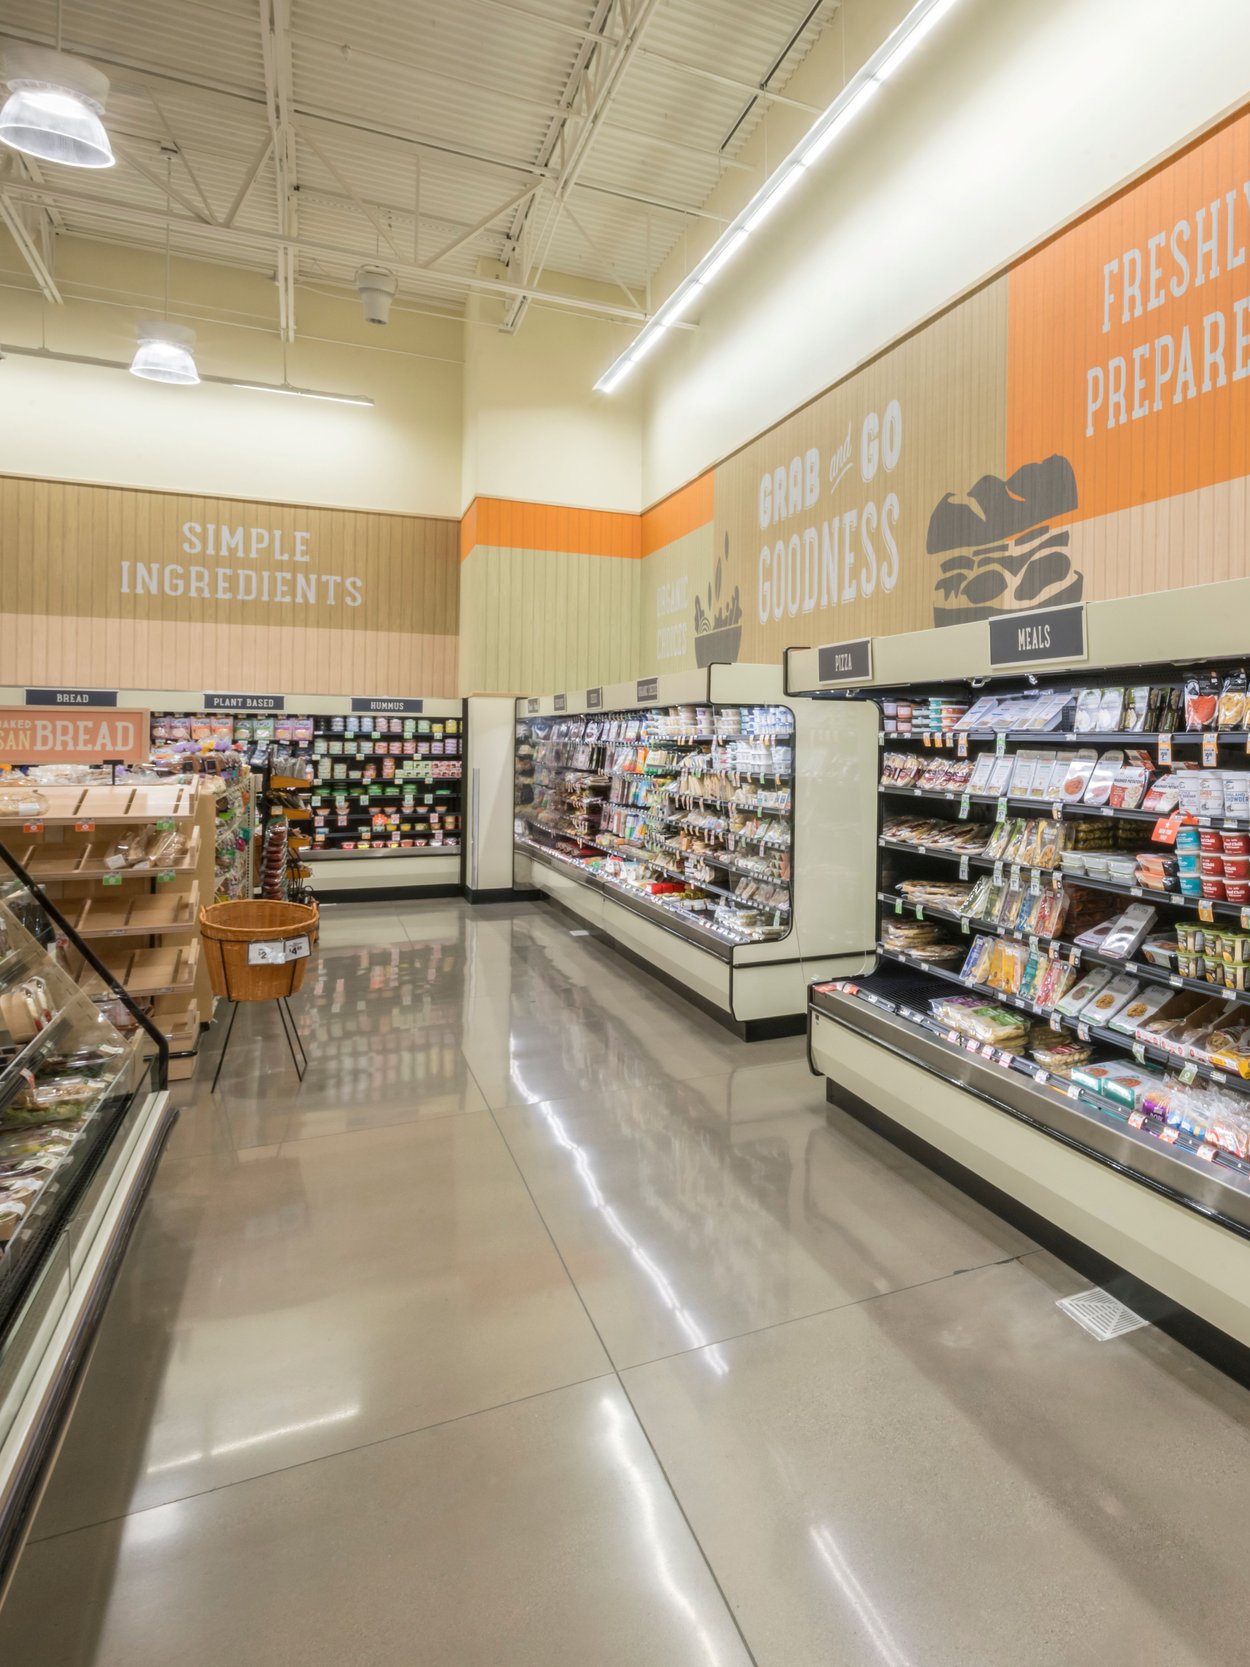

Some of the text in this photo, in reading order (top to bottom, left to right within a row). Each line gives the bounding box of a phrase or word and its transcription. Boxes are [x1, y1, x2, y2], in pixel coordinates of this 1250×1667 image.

[759, 399, 902, 531] GRAB and GO
[182, 522, 310, 562] SIMPLE
[758, 492, 900, 625] GOODNESS
[120, 561, 362, 607] INGREDIENTS
[657, 576, 688, 617] ORGANIC
[657, 623, 687, 660] CHOICES
[1018, 624, 1051, 651] MEALS
[835, 653, 852, 671] PIZZA
[57, 694, 89, 703] BREAD
[214, 698, 274, 709] PLANT BASED
[370, 702, 404, 710] HUMMUS
[33, 720, 134, 751] BREAD
